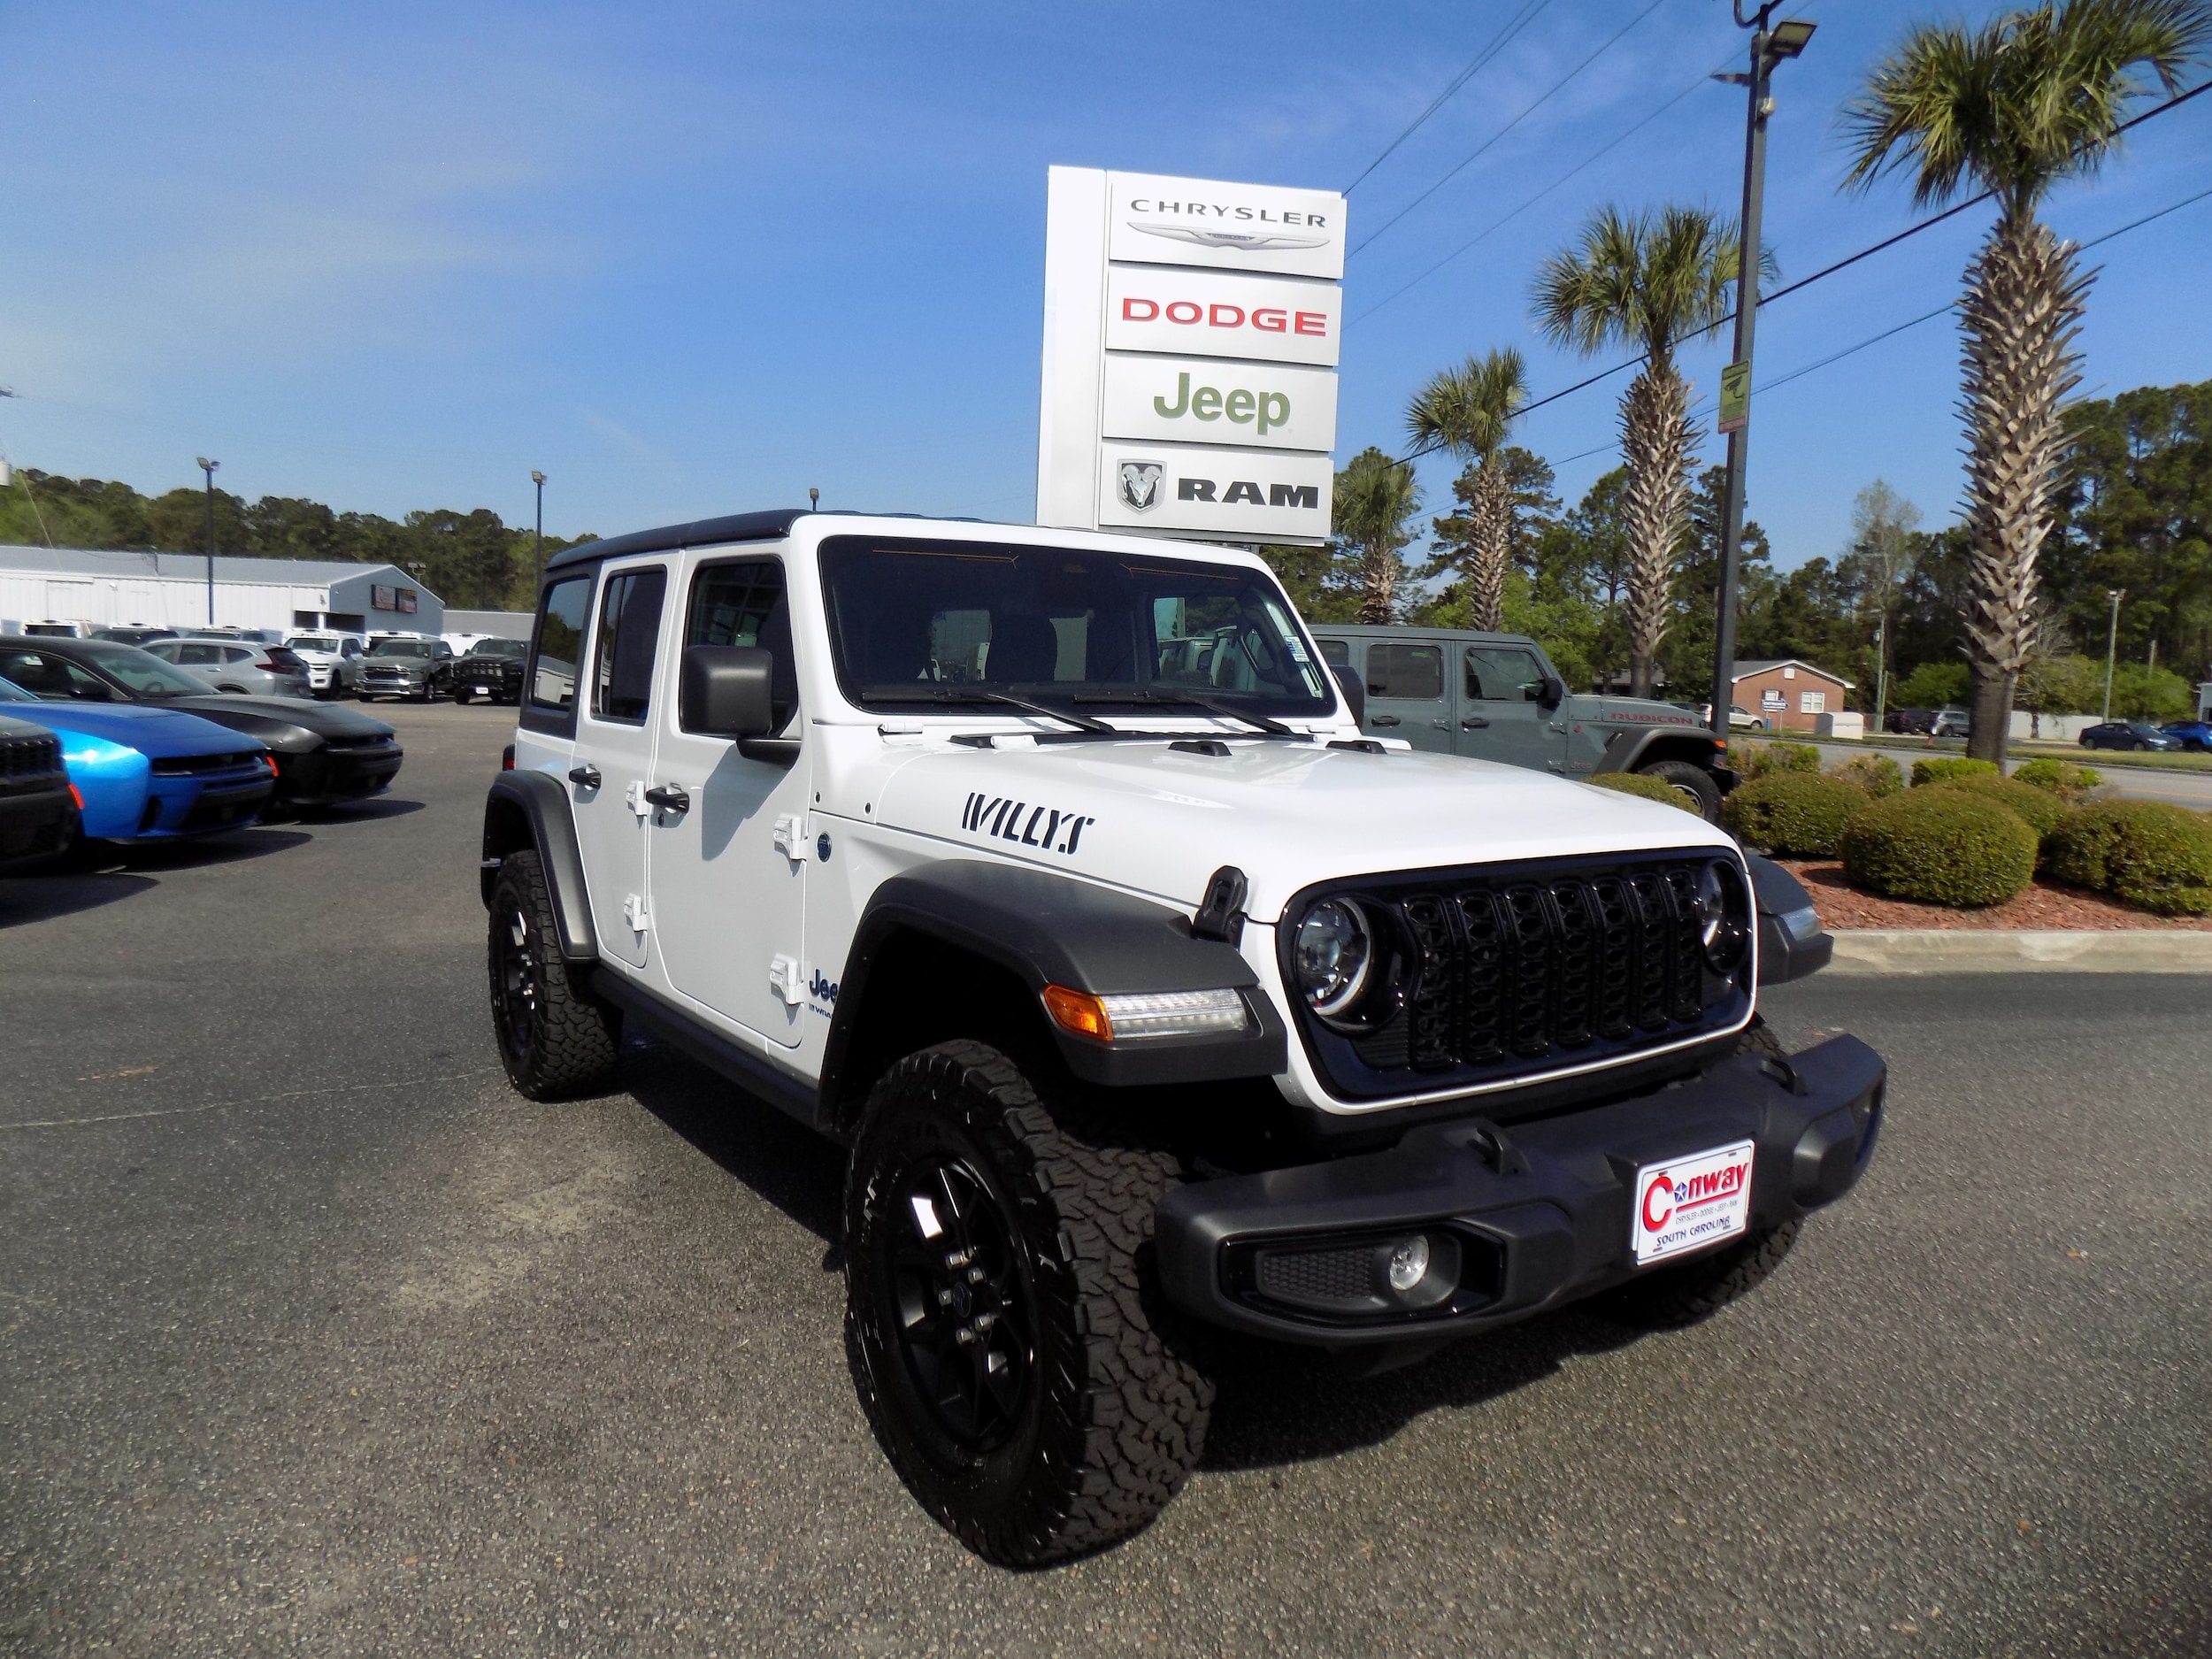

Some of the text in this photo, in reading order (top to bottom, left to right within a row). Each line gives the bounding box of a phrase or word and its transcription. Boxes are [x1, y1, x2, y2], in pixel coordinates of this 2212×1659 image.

[1131, 198, 1326, 228] CHRYSLER
[1122, 297, 1327, 337] DODGE
[1153, 372, 1291, 435] Jeep
[1178, 478, 1318, 510] RAM
[1611, 712, 1693, 725] RUBICON
[962, 792, 1096, 855] WILLYS
[809, 968, 839, 1003] Jee
[1656, 1215, 1731, 1247] SOUTH CAROLINA
